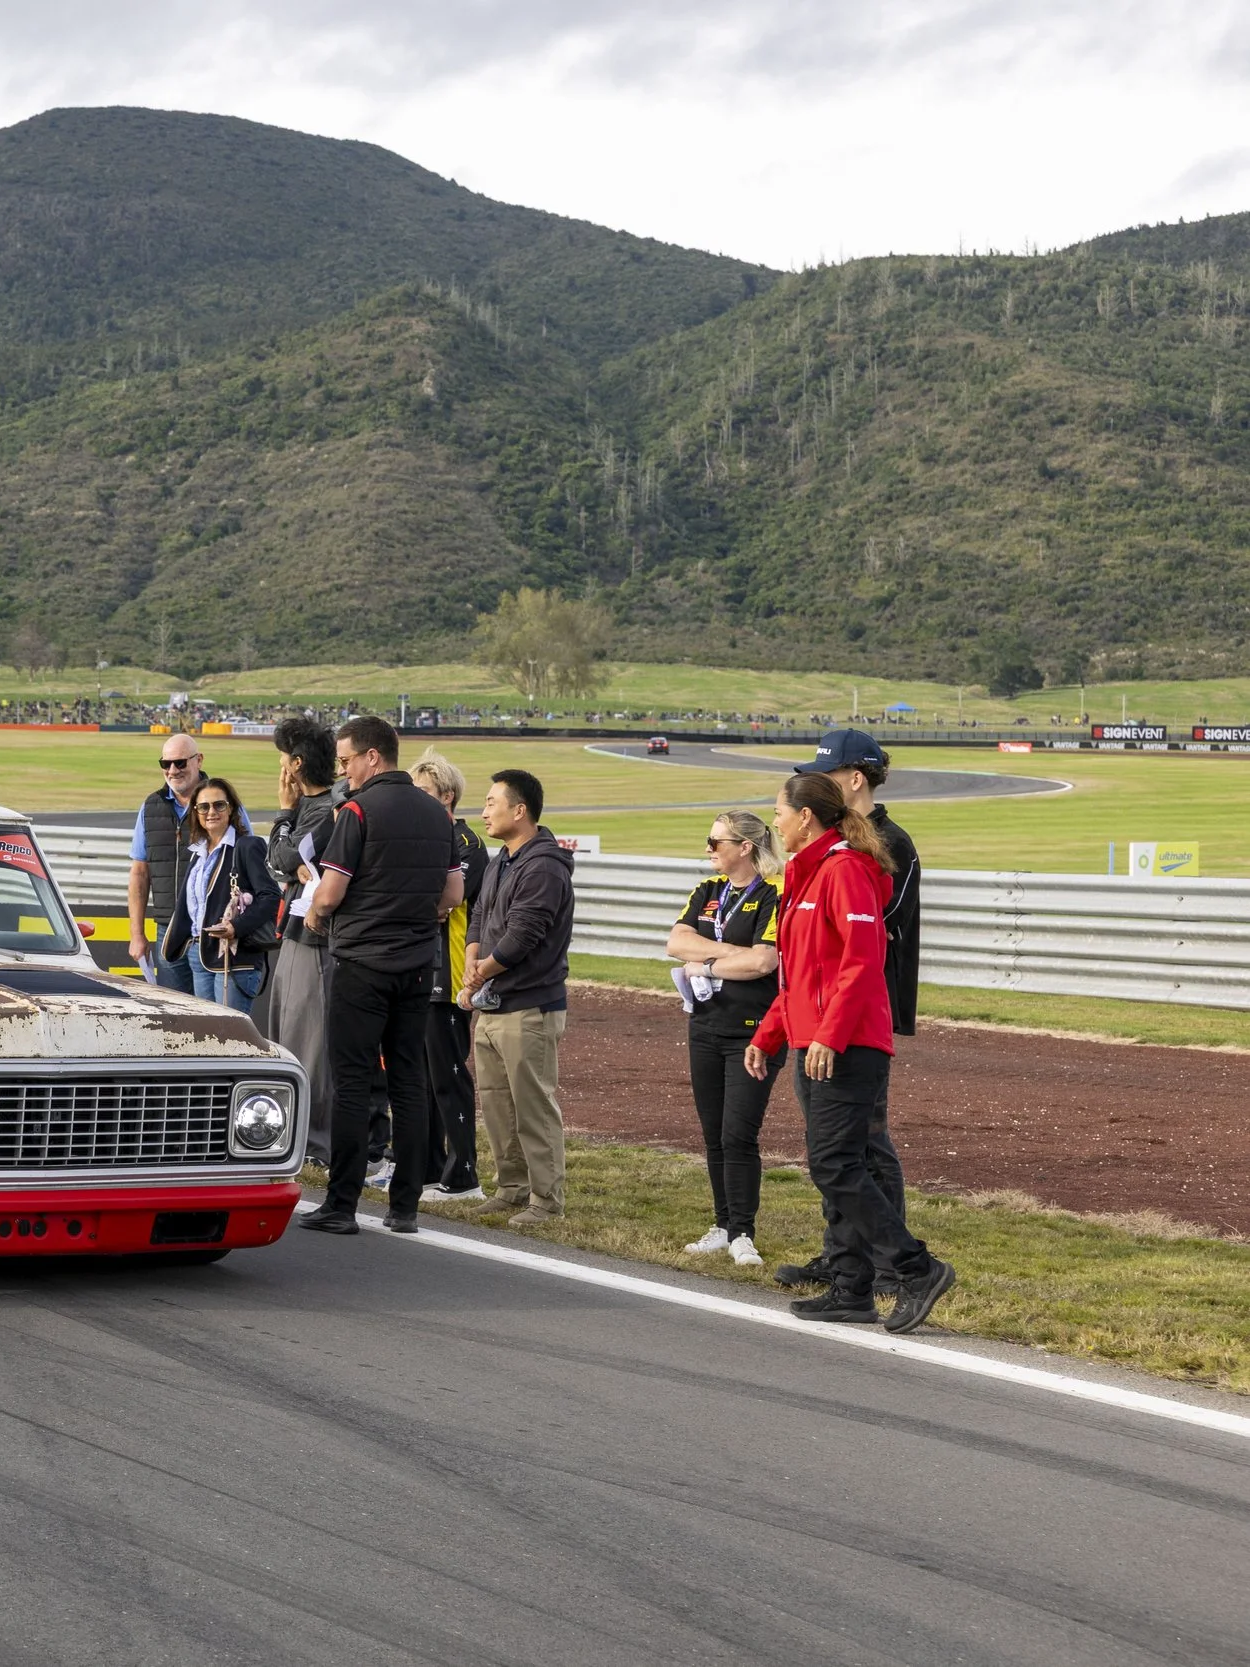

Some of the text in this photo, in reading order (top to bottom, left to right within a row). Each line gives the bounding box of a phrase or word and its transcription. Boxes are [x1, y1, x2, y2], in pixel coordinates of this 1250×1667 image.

[1103, 727, 1164, 739] SIGNEVENT
[1204, 728, 1250, 740] SIGNEVE
[1142, 743, 1169, 751] VANTAGE
[1185, 744, 1211, 752] VANTAGE
[1158, 850, 1193, 861] ultimate
